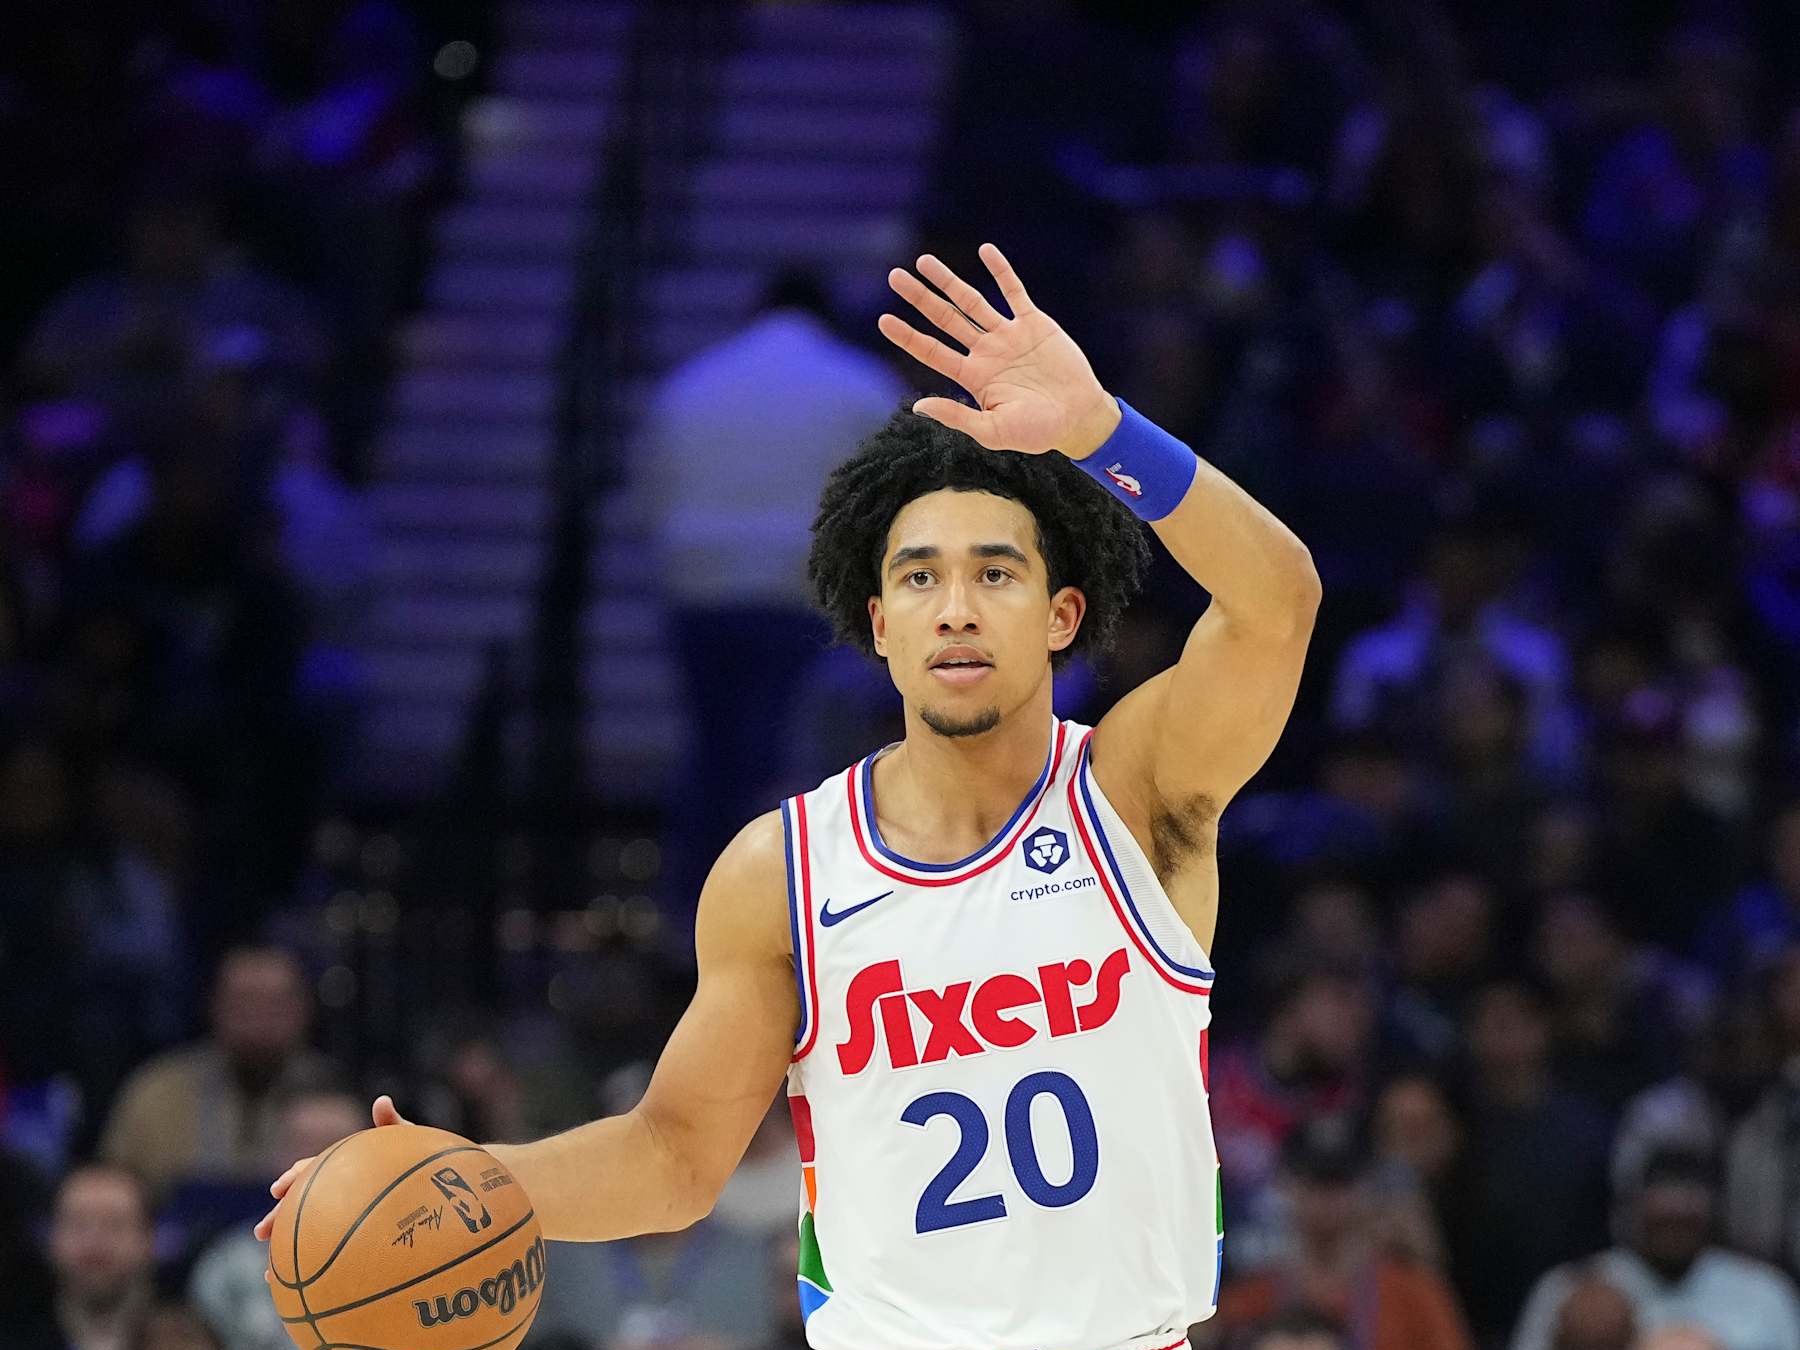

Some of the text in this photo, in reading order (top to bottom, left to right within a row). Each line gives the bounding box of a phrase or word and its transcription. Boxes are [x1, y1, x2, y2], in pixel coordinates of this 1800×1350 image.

[1010, 874, 1096, 901] crypto.com
[835, 947, 1131, 1076] Sixers
[900, 1070, 1100, 1234] 20
[413, 1234, 545, 1328] Wilson
